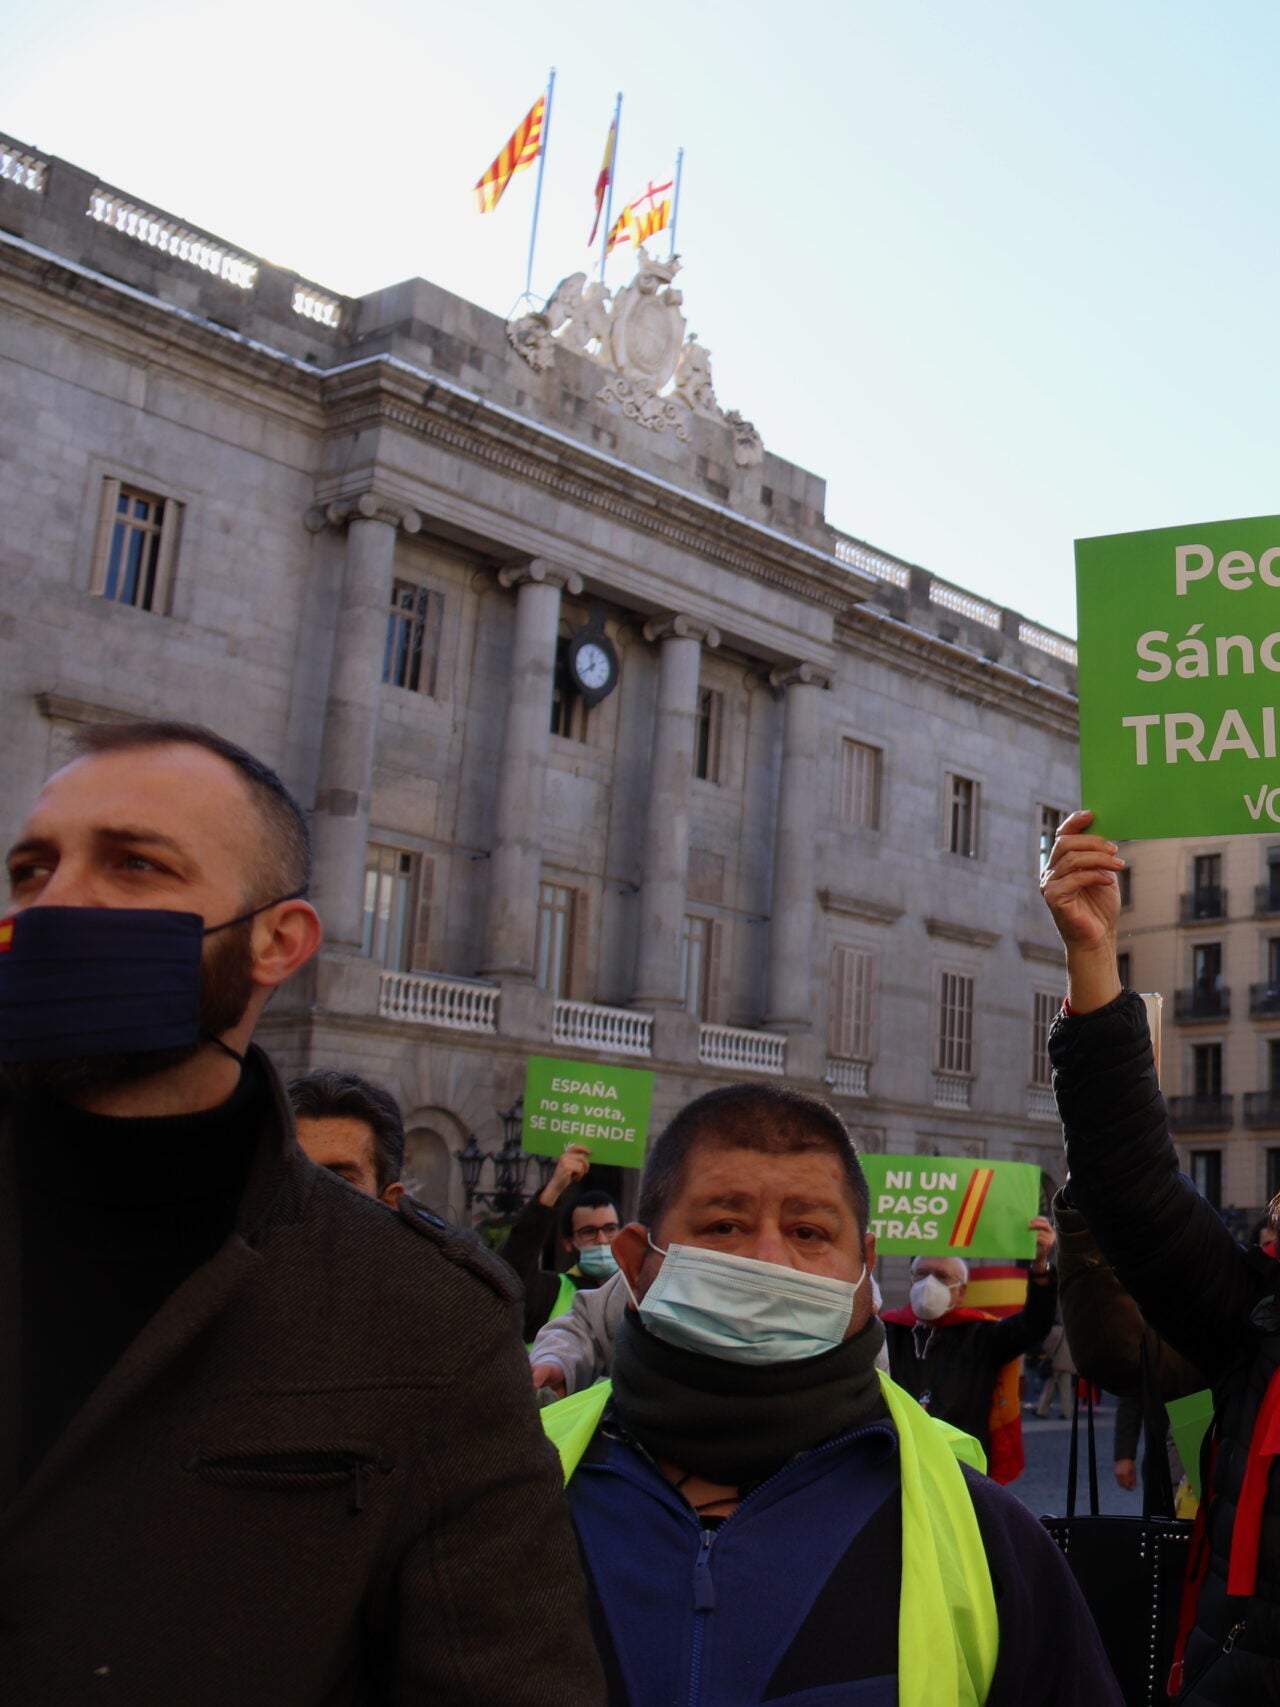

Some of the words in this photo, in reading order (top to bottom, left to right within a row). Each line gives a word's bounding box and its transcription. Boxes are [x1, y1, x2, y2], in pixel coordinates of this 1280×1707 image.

[551, 1078, 618, 1099] ESPAÑA
[540, 1099, 559, 1112] no
[561, 1102, 579, 1114] se
[583, 1105, 626, 1123] vota,
[529, 1115, 547, 1130] SE
[550, 1118, 636, 1142] DEFIENDE
[885, 1171, 912, 1190] NI
[919, 1172, 958, 1191] UN
[877, 1195, 949, 1216] PASO
